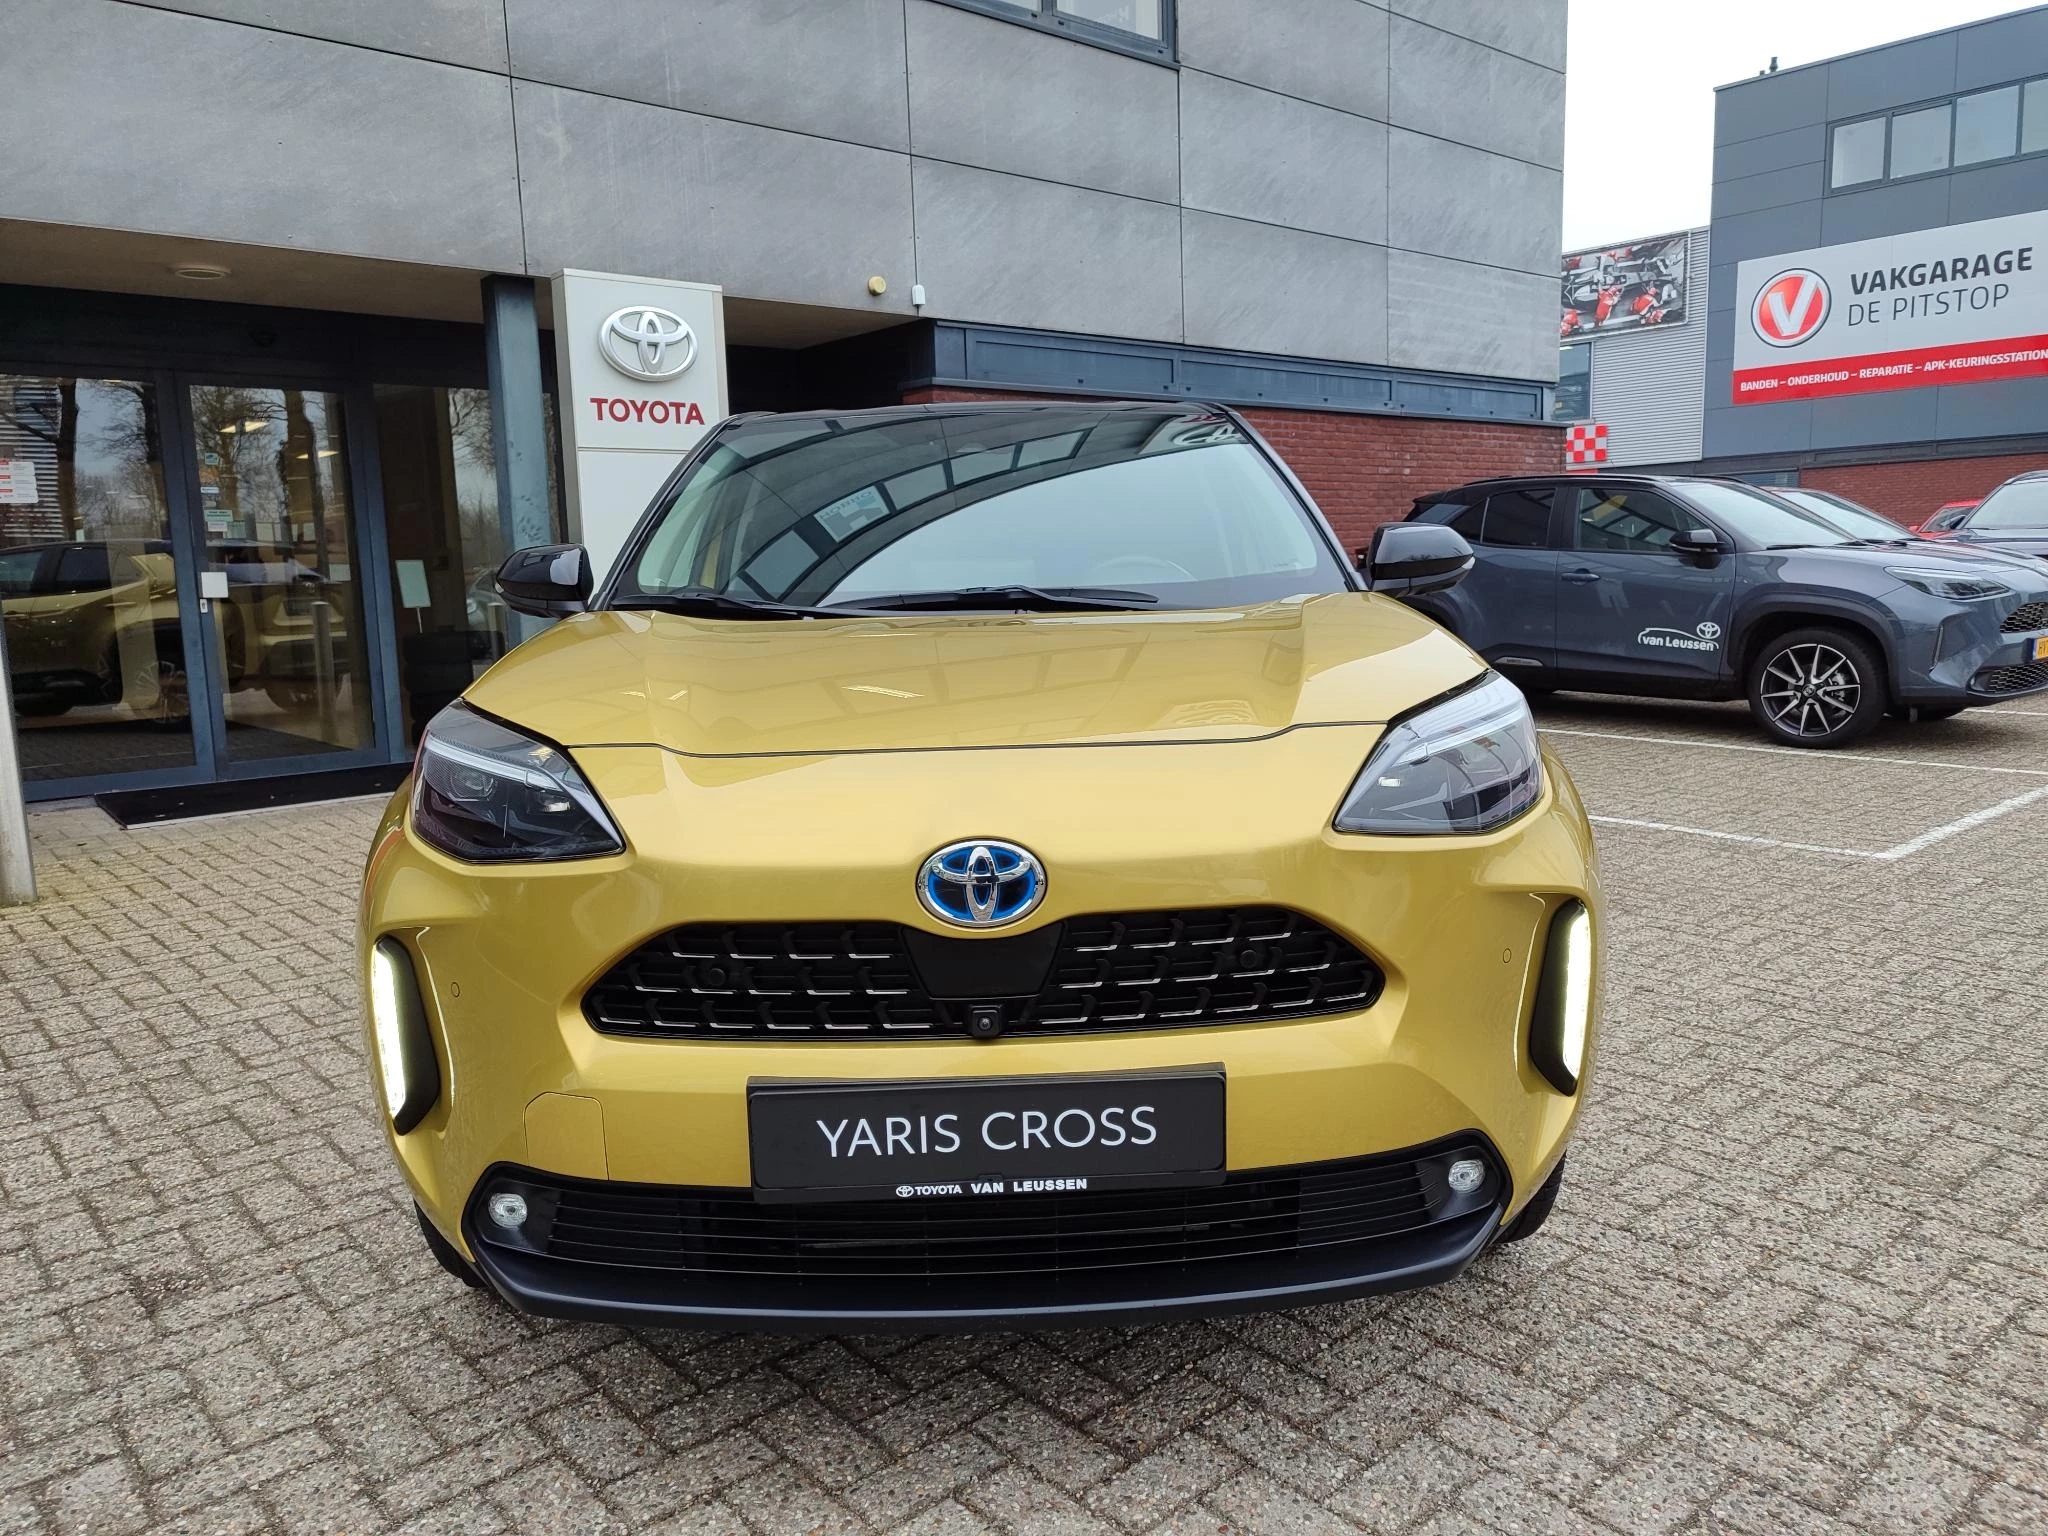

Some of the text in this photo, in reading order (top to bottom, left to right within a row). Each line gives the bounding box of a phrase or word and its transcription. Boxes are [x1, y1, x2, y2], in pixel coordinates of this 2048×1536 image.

[1850, 247, 2033, 296] VAKGARAGE
[1848, 283, 2009, 326] DE PITSTOP
[1740, 378, 1779, 392] BANDEN
[1787, 371, 1849, 387] ONDERHOUD
[1859, 363, 1914, 379] REPARATIE
[590, 398, 705, 425] TOYOTA
[1642, 636, 1715, 651] van Leussen
[816, 1106, 1157, 1158] YARIS CROSS
[915, 1178, 1088, 1195] TOYOTA VAN LEUSSEN
